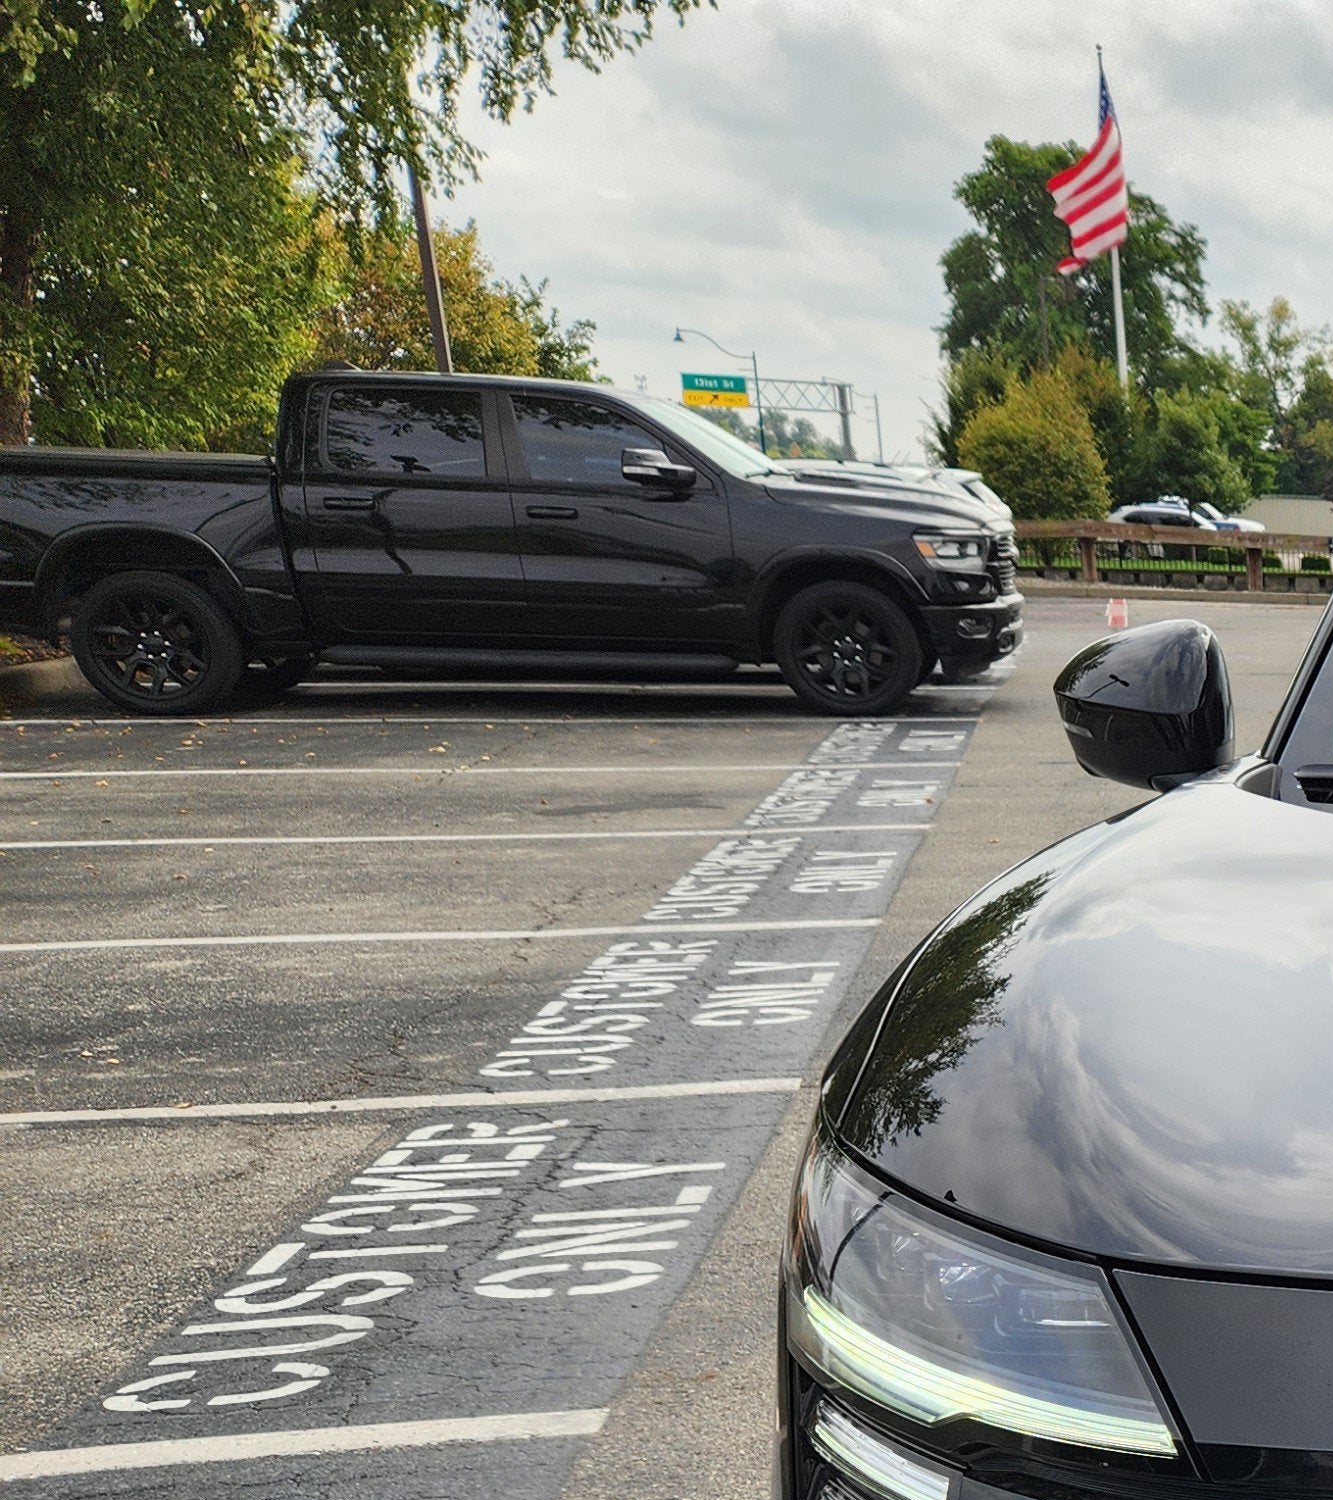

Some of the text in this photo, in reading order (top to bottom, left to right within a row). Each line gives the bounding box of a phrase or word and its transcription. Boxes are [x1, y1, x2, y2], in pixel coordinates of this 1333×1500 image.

[723, 379, 735, 389] St
[789, 851, 898, 893] ONLY
[479, 940, 719, 1077] CUSTOMER
[690, 961, 841, 1027] ONLY
[103, 1119, 570, 1412] CUSTOMER
[474, 1162, 727, 1299] ONLY
